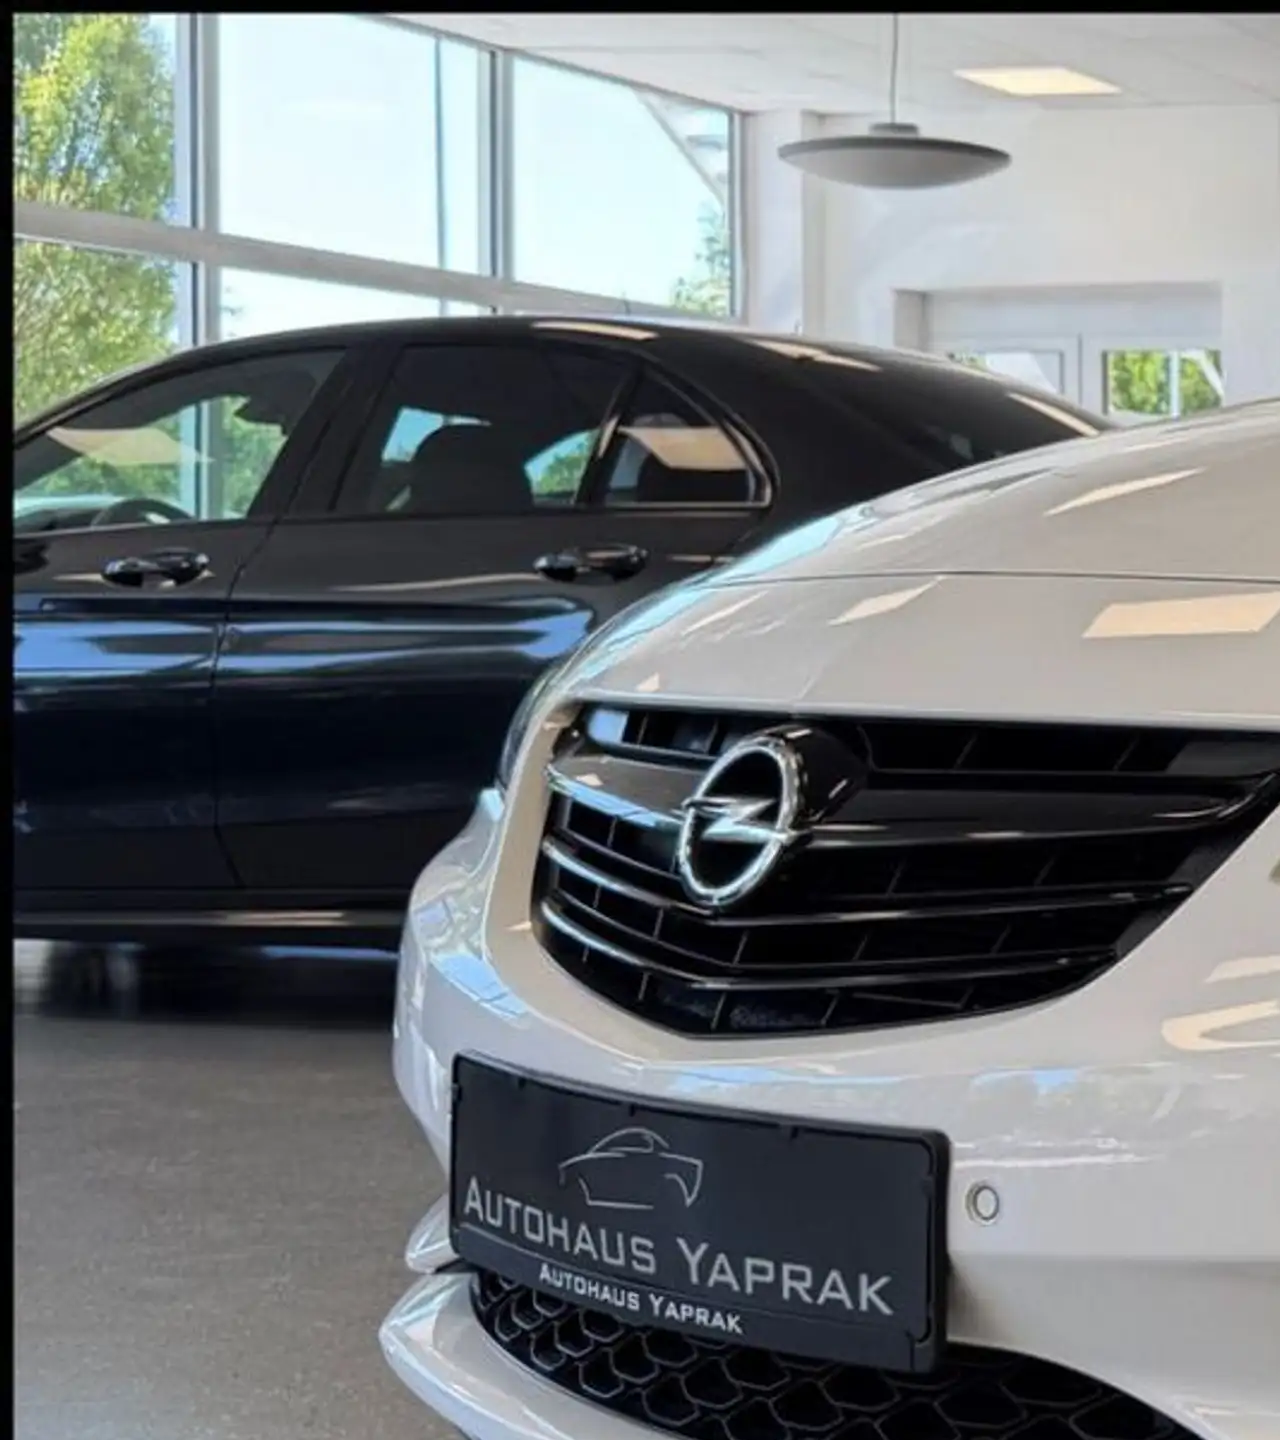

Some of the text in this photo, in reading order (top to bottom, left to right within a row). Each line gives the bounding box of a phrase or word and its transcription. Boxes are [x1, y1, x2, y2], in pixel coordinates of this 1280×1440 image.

[463, 1175, 893, 1316] AUTOHAUS YAPRAK
[538, 1262, 743, 1335] AUTOHAUS YAPRAK
